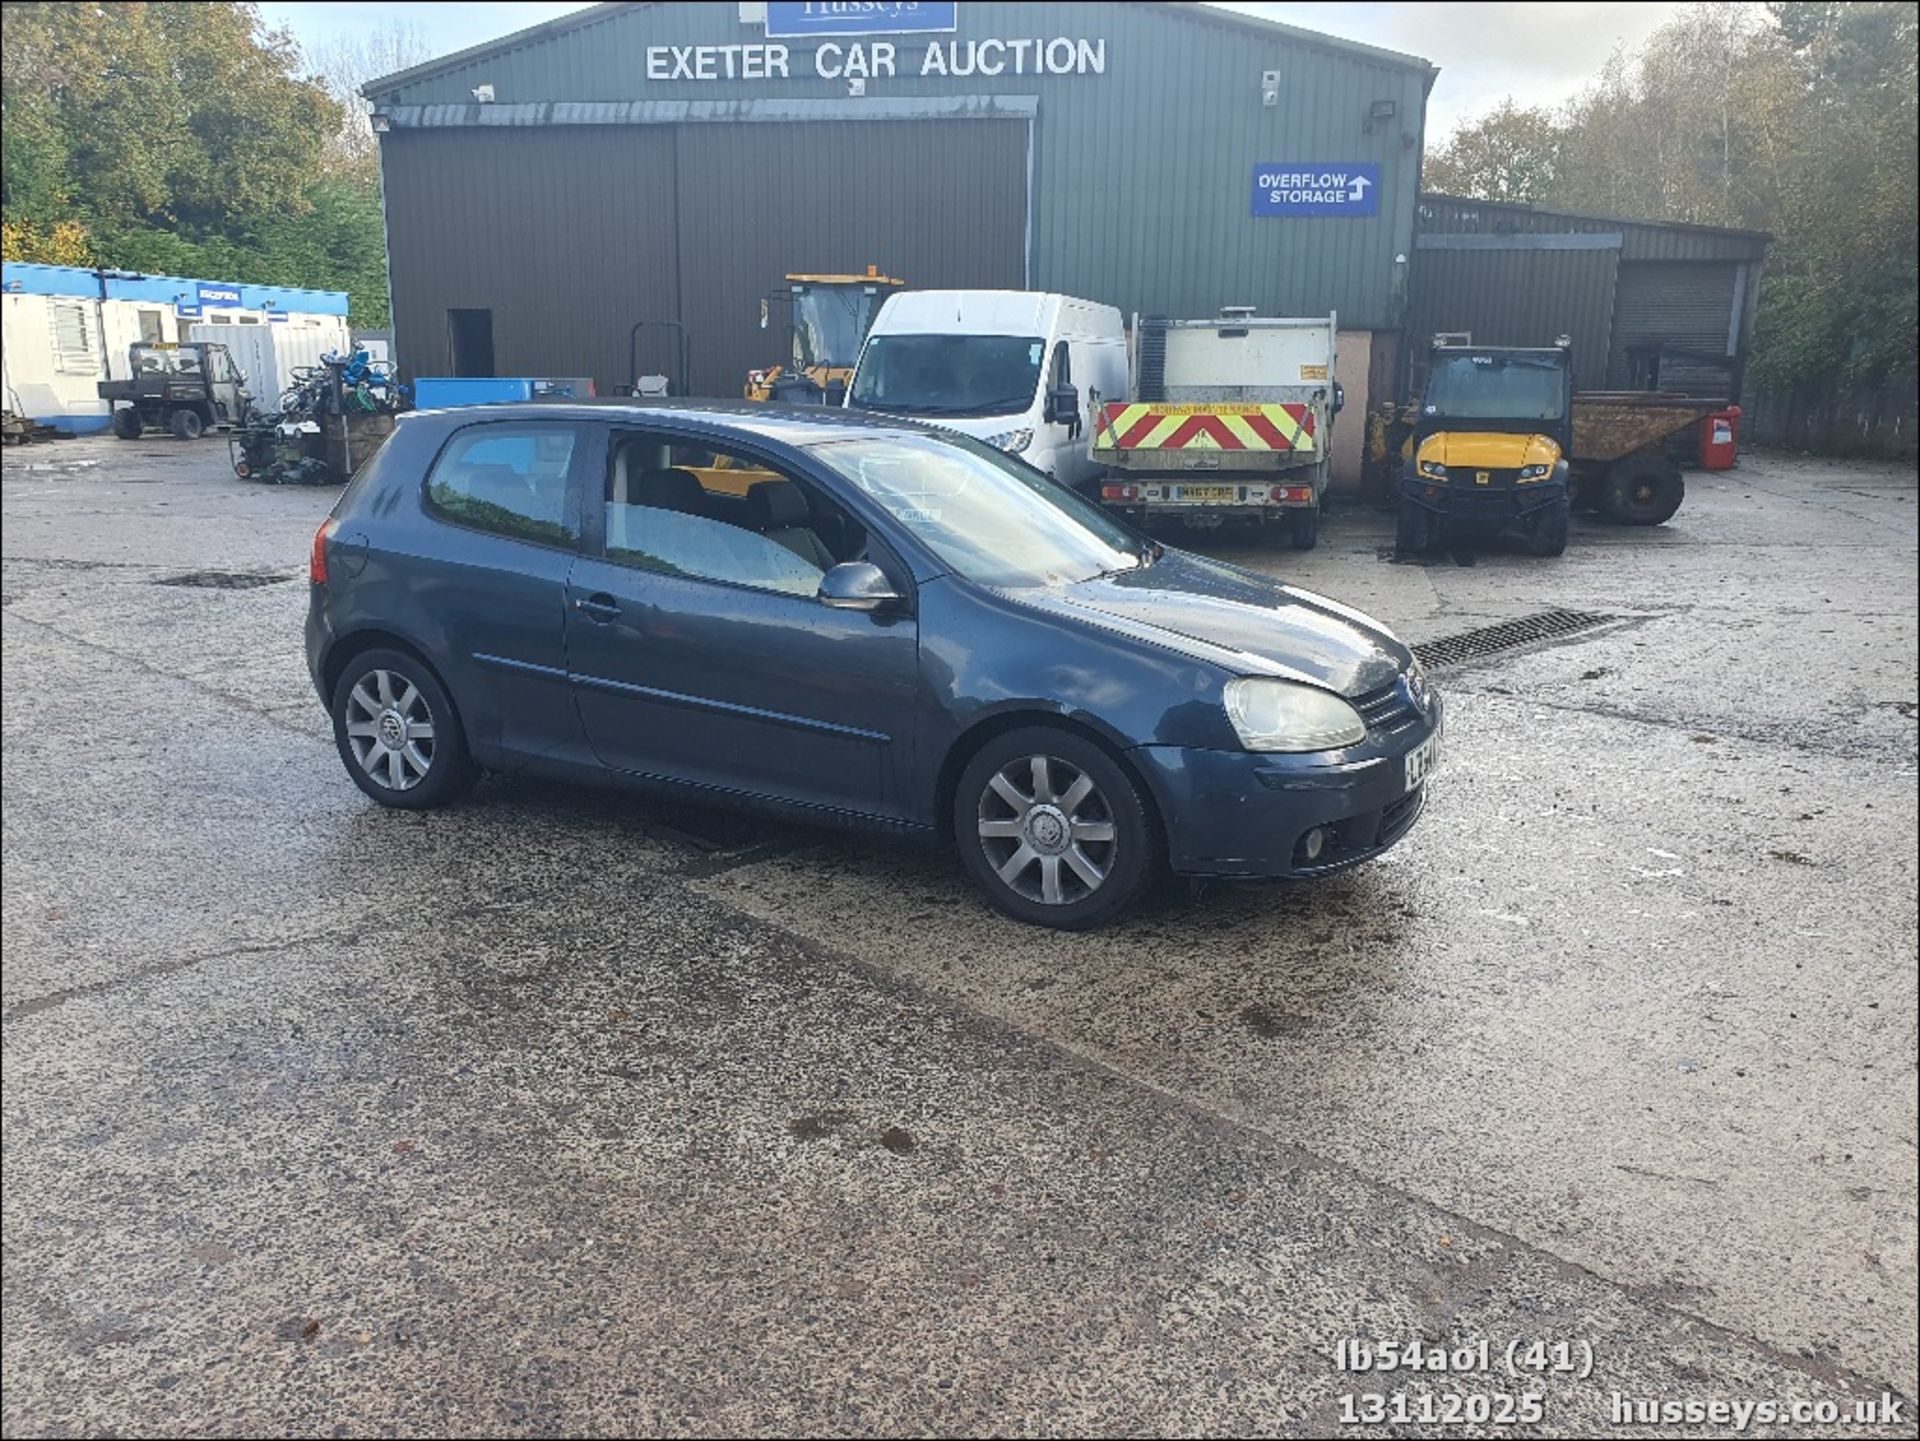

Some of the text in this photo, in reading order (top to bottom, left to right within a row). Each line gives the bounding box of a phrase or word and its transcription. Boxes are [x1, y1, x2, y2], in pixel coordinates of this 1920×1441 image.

[646, 37, 1105, 80] EXETER CAR AUCTION
[1258, 173, 1348, 204] OVERFLOW STORAGE
